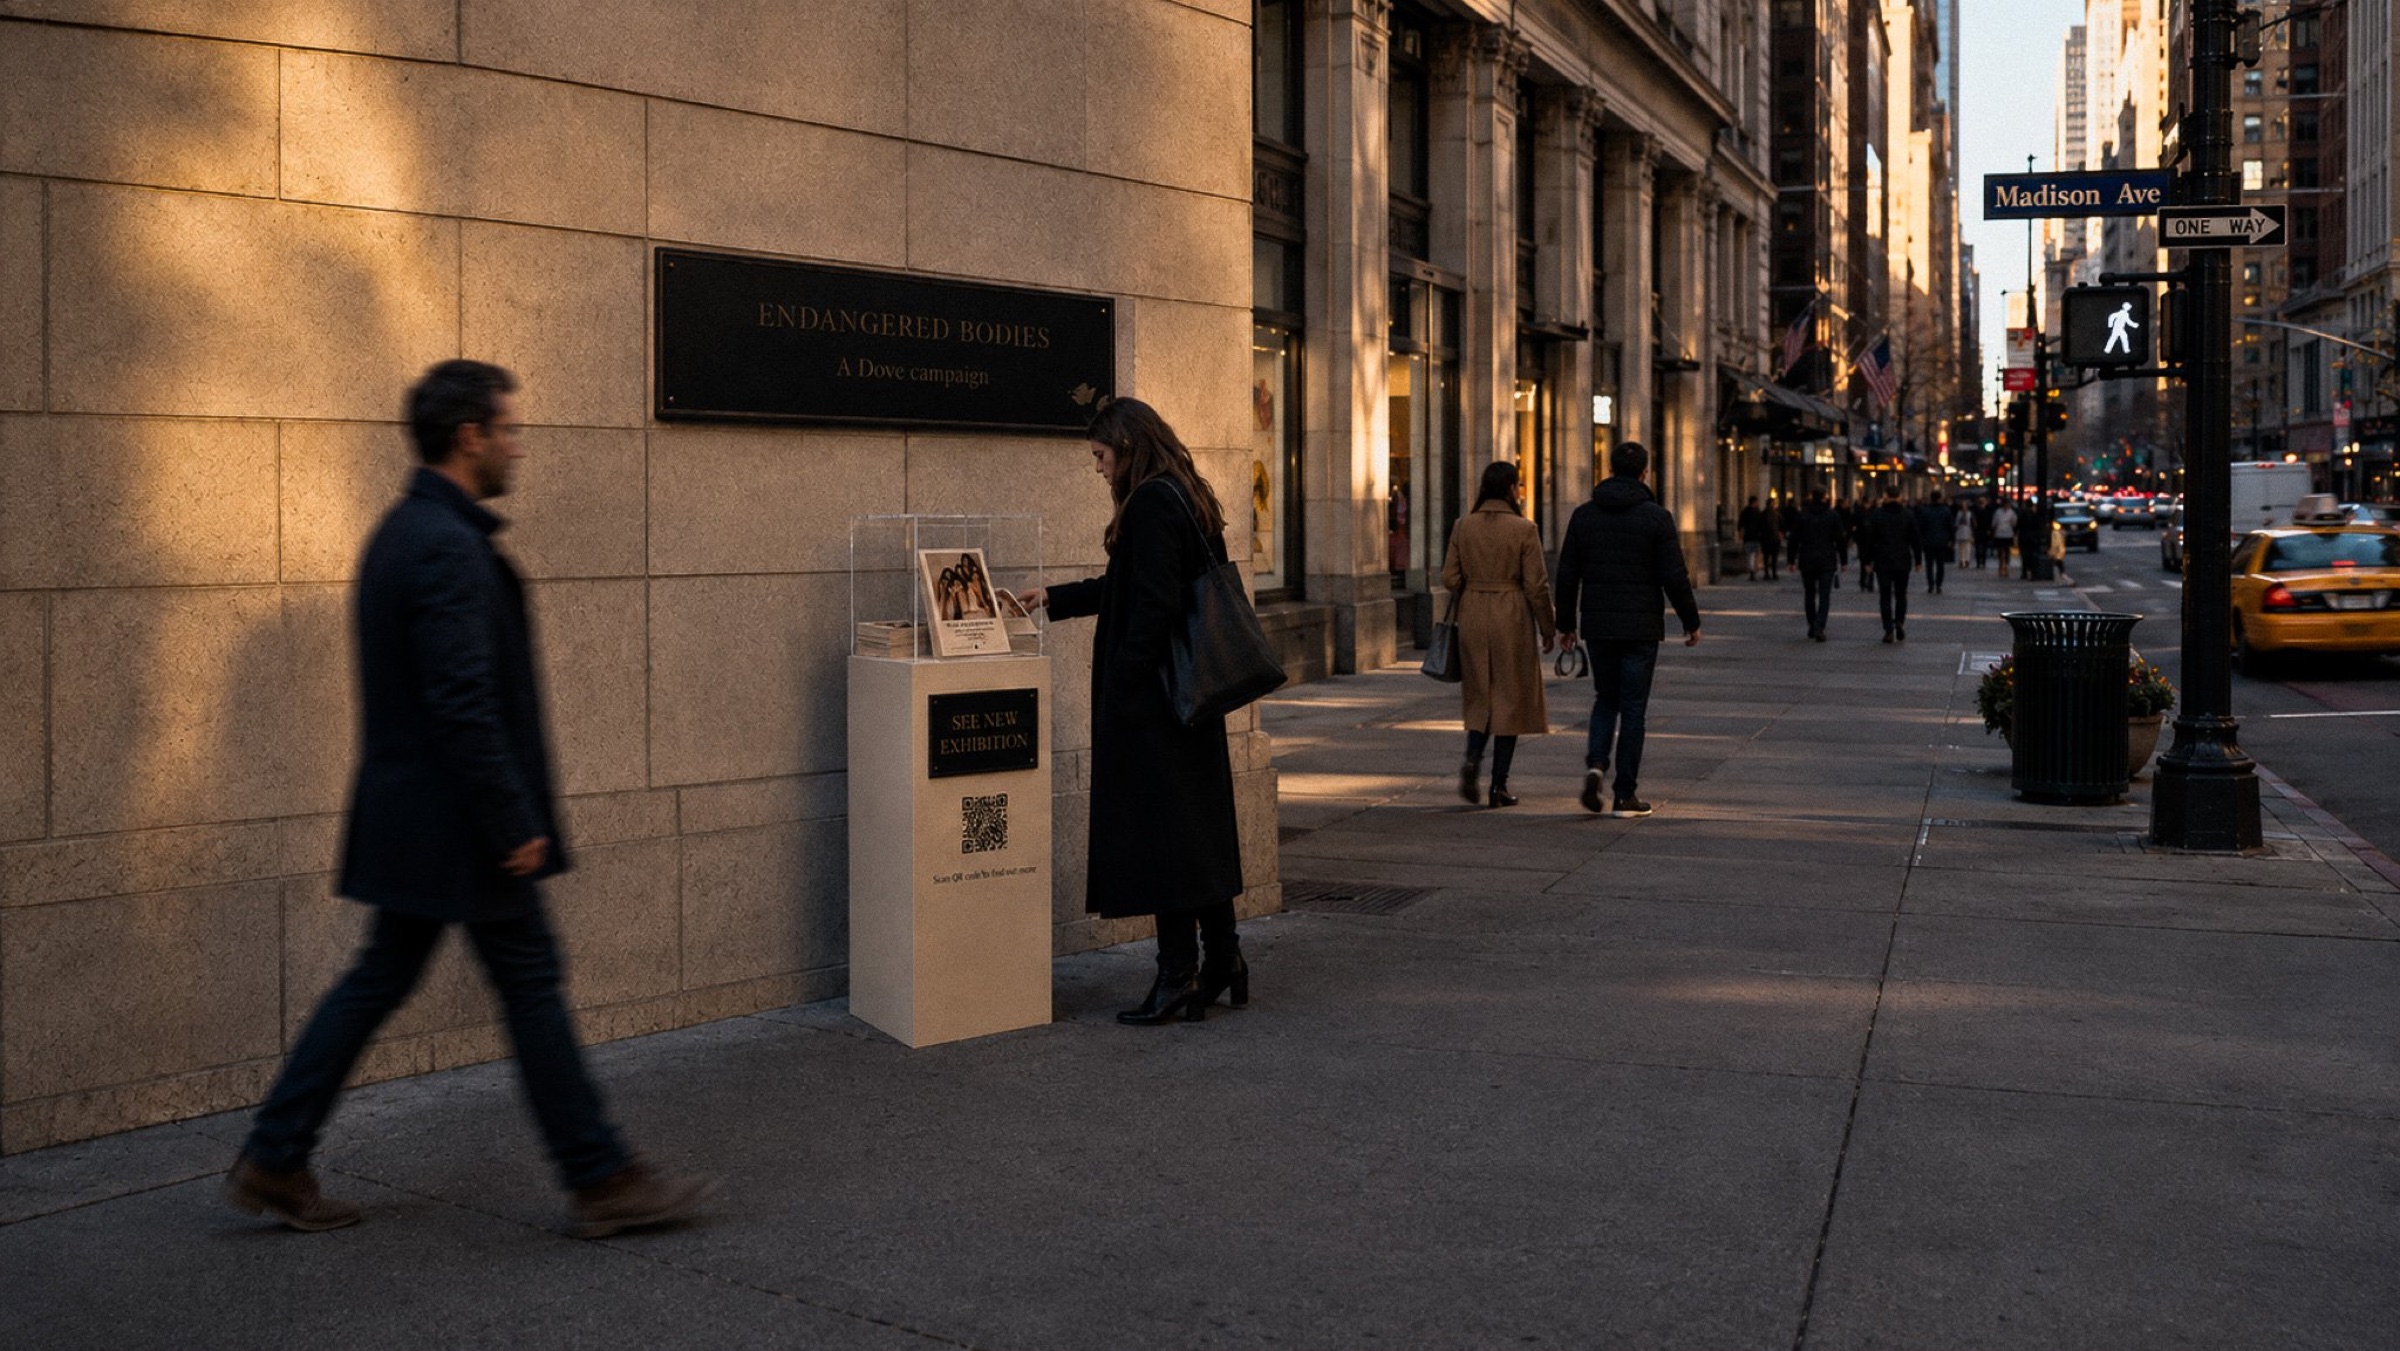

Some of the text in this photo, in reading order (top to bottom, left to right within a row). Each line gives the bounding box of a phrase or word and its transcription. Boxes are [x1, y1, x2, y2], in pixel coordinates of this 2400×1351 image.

[1993, 182, 2161, 208] Madison Ave
[2174, 218, 2266, 235] ONE WAY
[757, 302, 1051, 350] ENDANGERED BODIES
[836, 357, 989, 389] A Dove campaign
[952, 710, 1019, 731] SEE NEW
[940, 732, 1029, 756] EXHIBITION
